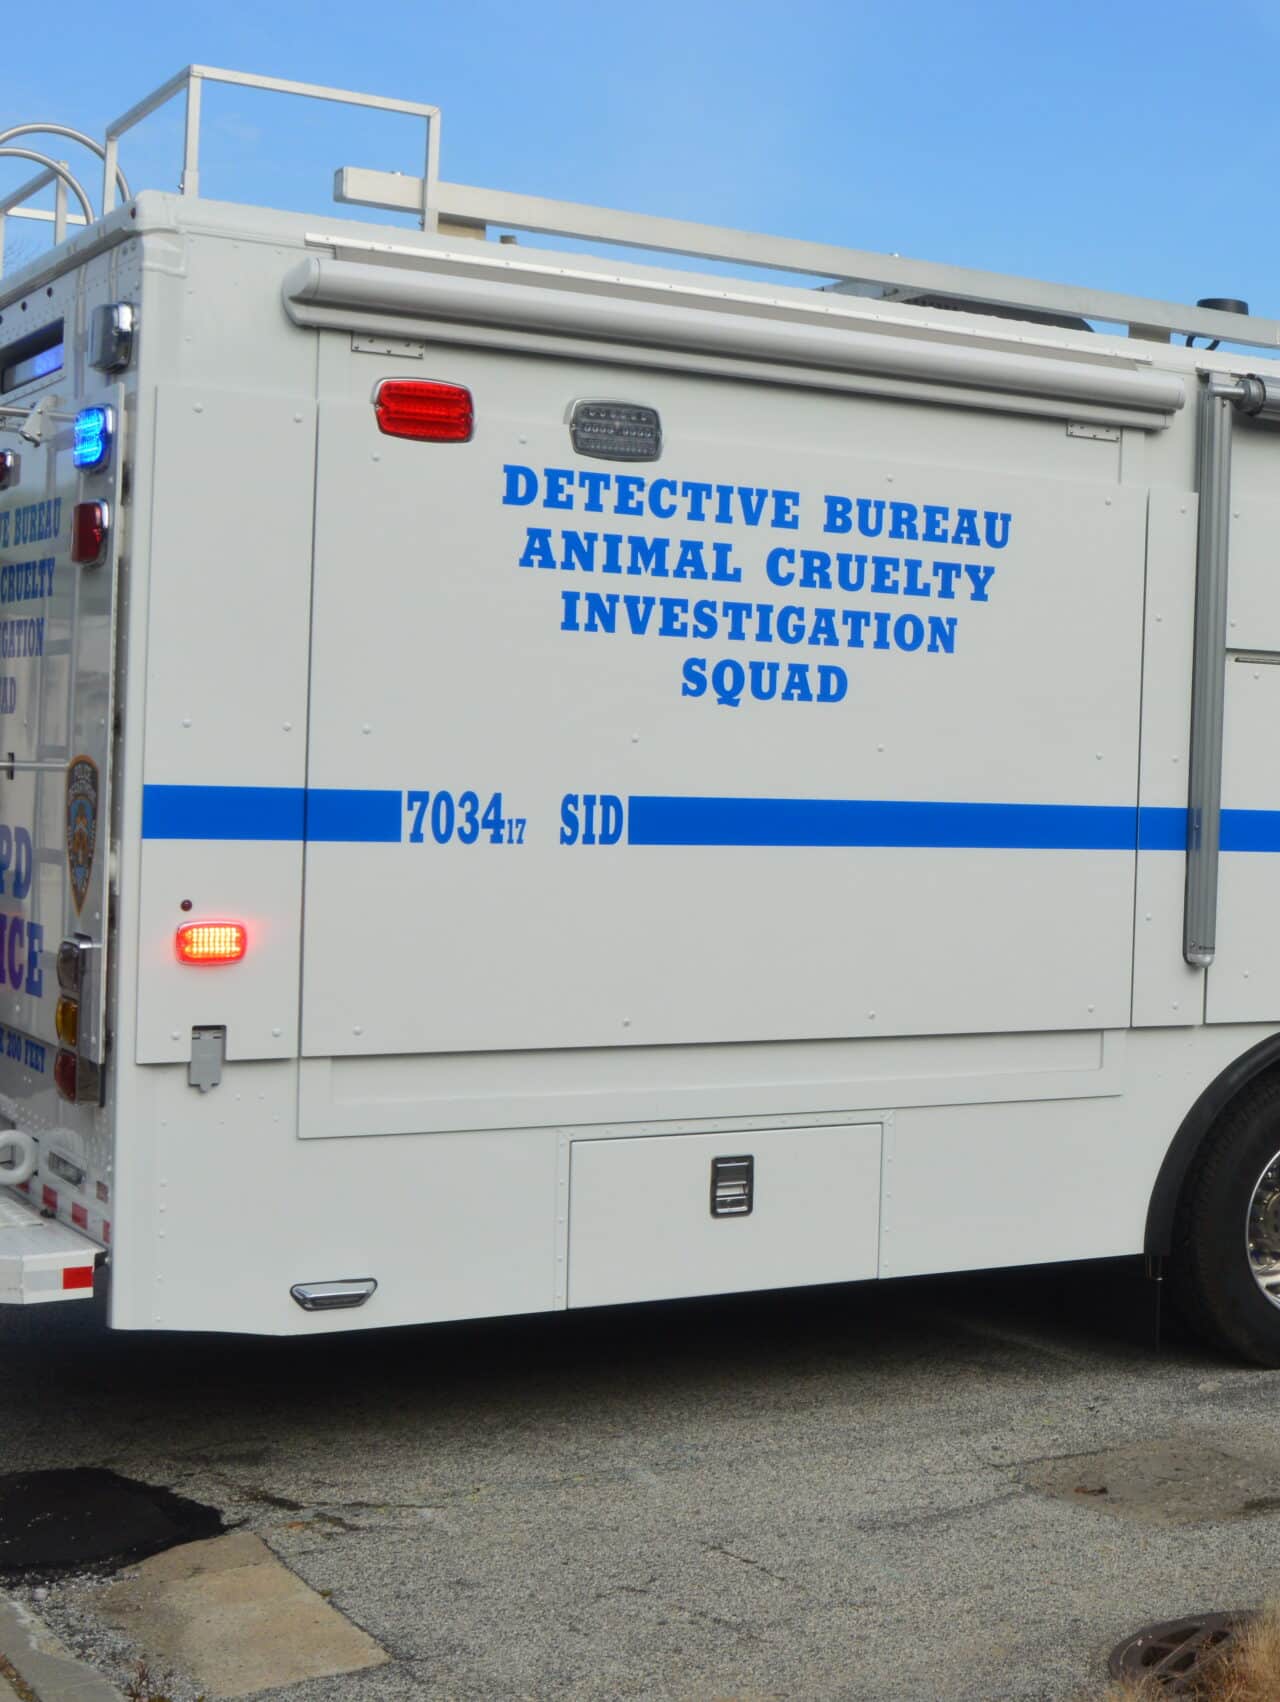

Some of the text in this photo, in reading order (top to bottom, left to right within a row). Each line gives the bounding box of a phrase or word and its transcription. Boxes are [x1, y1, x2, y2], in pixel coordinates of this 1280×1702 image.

[14, 497, 62, 546] BUREAU
[502, 464, 1012, 549] DETECTIVE BUREAU
[1, 557, 55, 603] CRUELTY
[519, 527, 995, 602] ANIMAL CRUELTY
[0, 618, 45, 658] GATION
[560, 591, 957, 654] INVESTIGATION
[682, 657, 848, 707] SQUAD
[407, 790, 505, 844] 7034
[560, 793, 623, 845] SID
[25, 1039, 45, 1072] FEET
